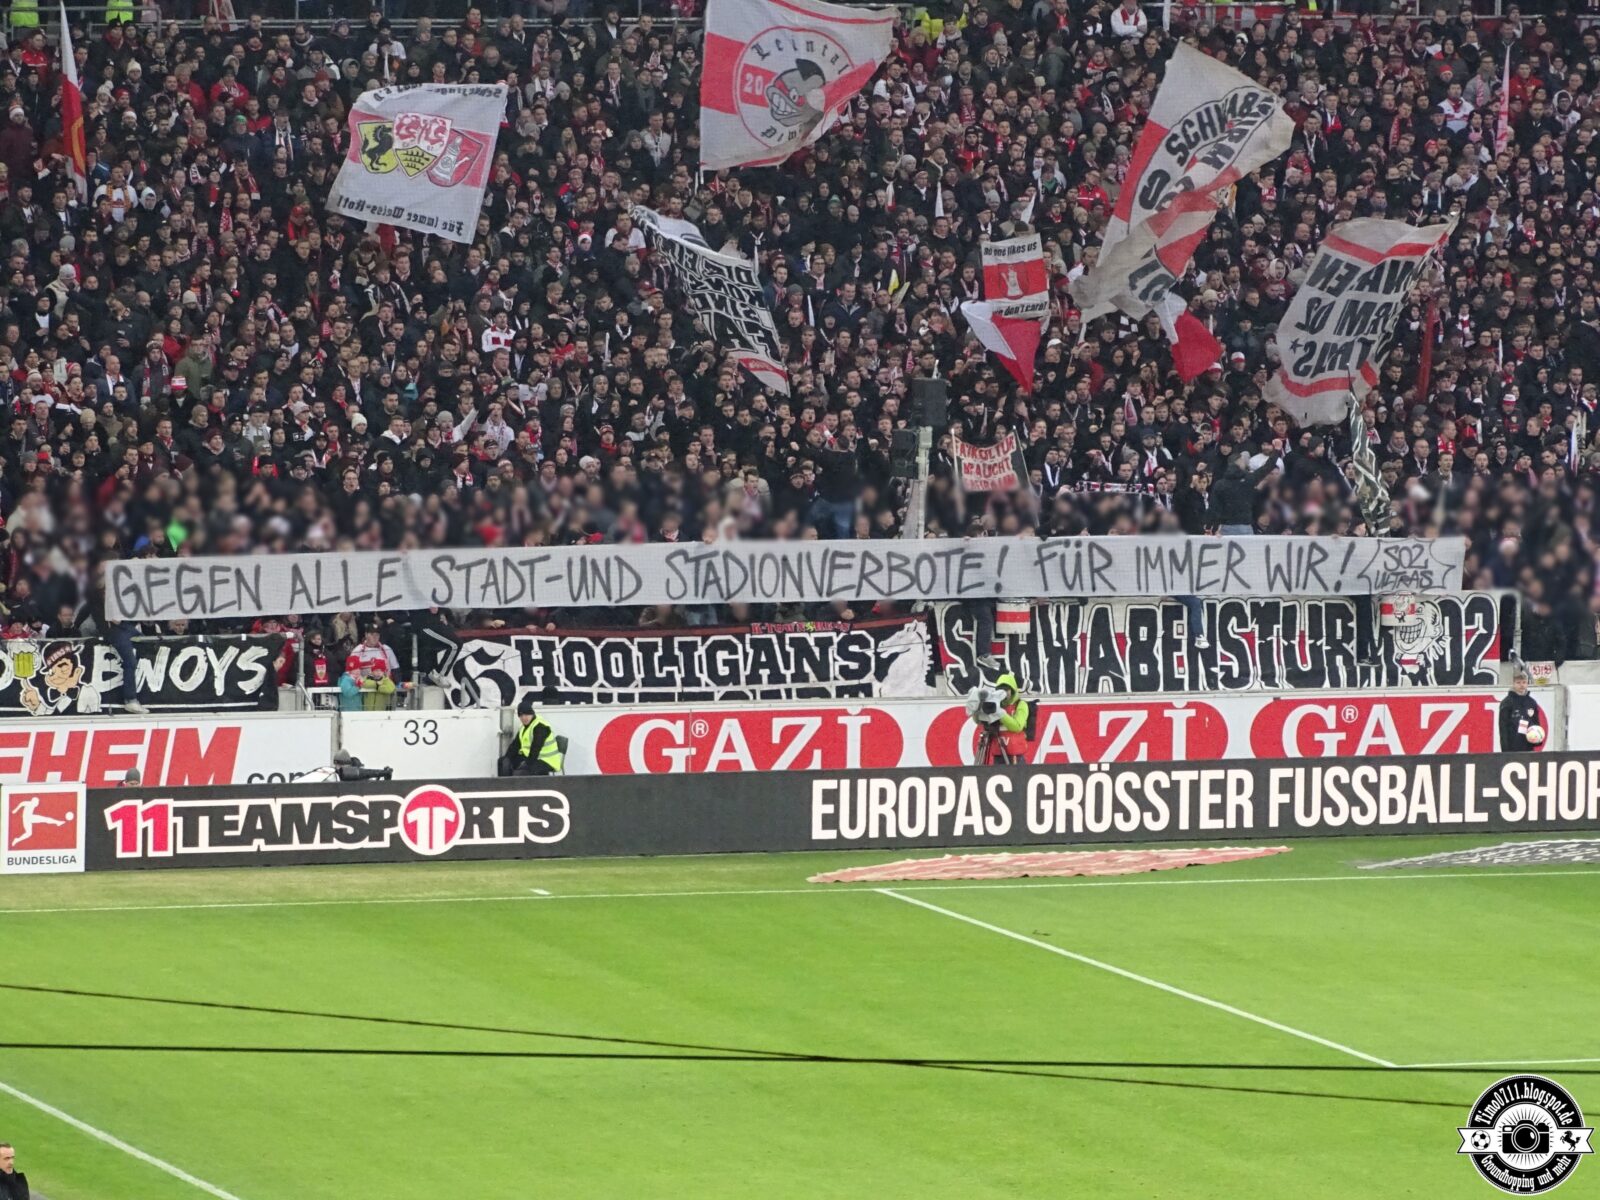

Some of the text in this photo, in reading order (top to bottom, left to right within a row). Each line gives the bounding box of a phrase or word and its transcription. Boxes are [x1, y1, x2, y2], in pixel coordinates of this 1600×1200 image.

[112, 563, 262, 618] GEGEN
[290, 557, 403, 609] ALLE
[1034, 539, 1117, 592] FÜR
[1136, 539, 1251, 593] IMMER
[1266, 541, 1356, 593] WIR!
[511, 630, 876, 688] HOOLIGANS
[403, 719, 439, 746] 33
[811, 774, 1013, 840] EUROPAS
[1026, 763, 1255, 834] GRÖSSTER
[7, 855, 77, 867] BUNDESLIGA
